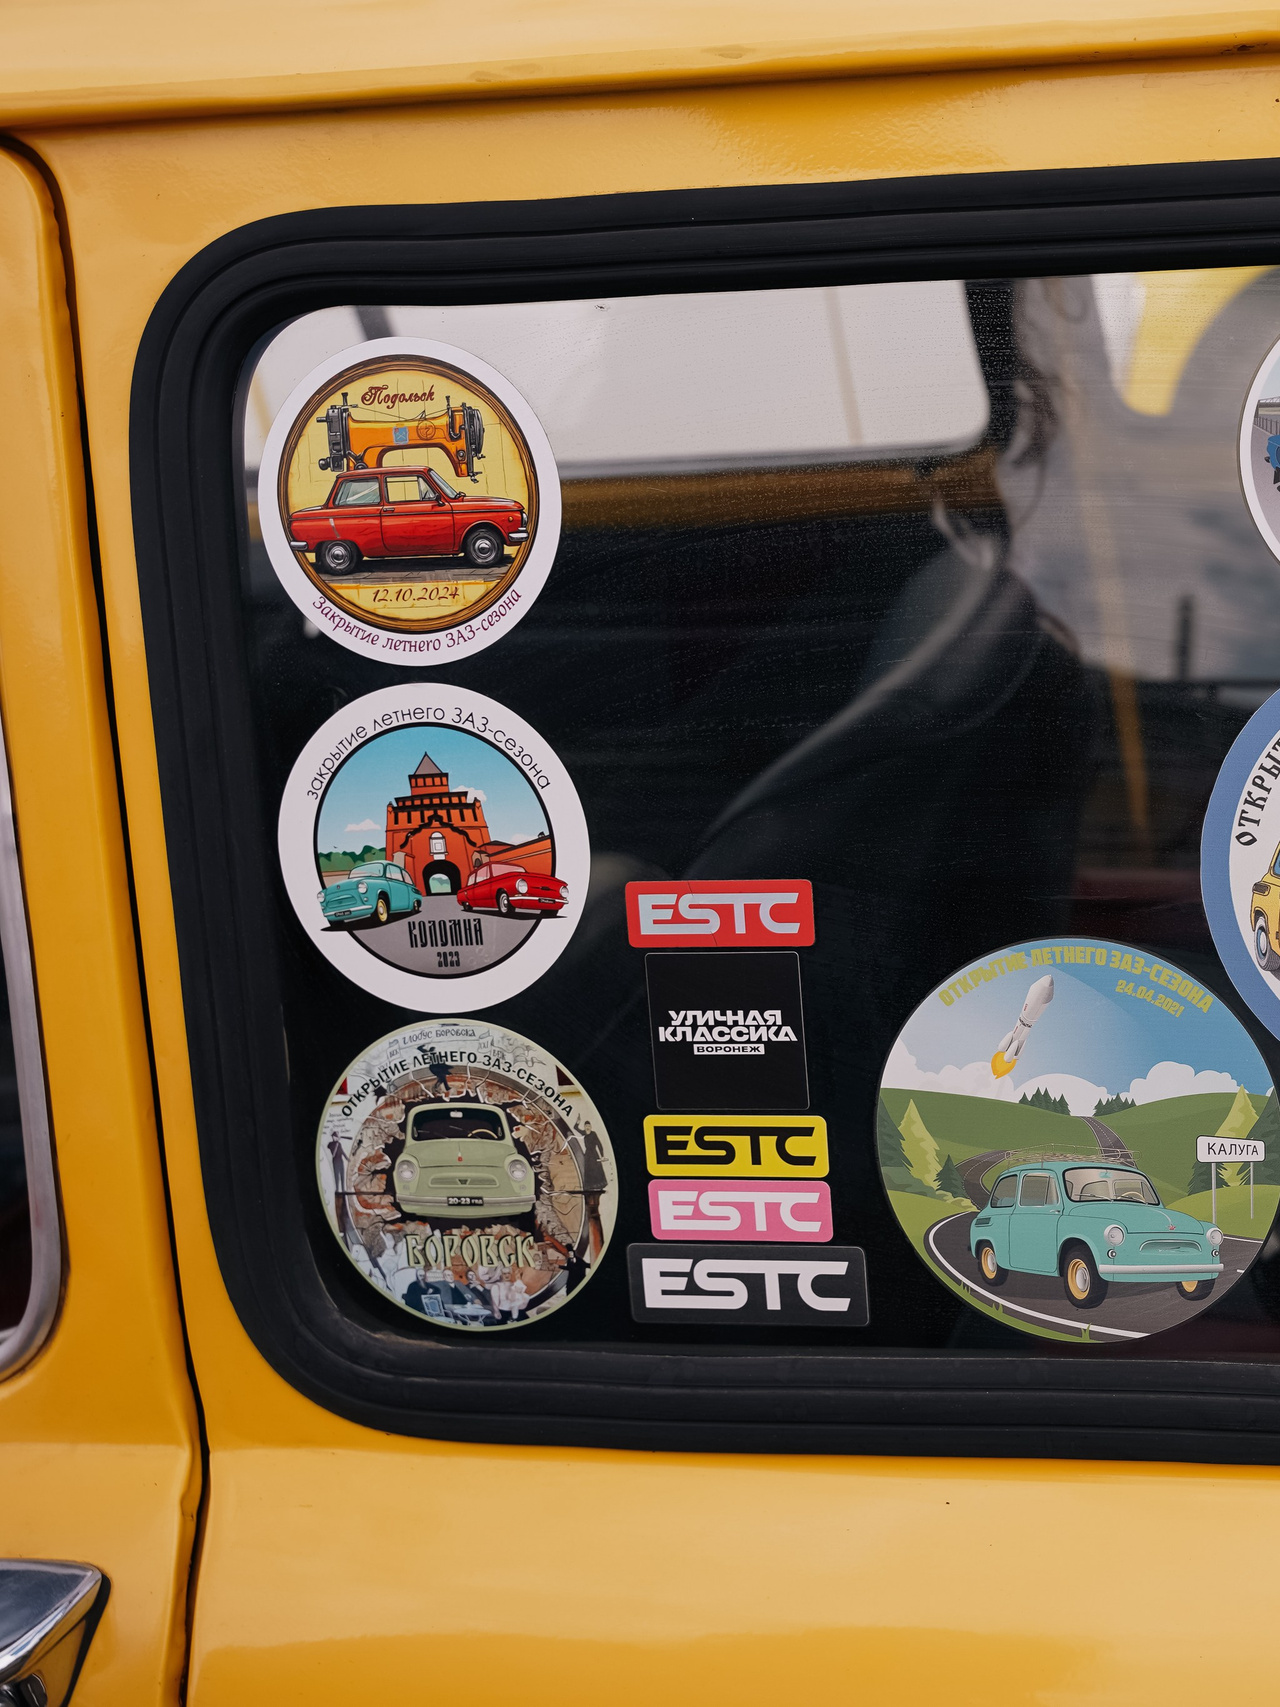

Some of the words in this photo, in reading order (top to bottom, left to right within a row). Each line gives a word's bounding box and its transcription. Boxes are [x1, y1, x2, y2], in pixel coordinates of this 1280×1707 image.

[361, 384, 435, 409] Подольск
[372, 585, 460, 603] 12.10.2024
[312, 596, 380, 646] Закрытие
[382, 638, 442, 652] летнего
[445, 588, 522, 648] ЗАЗ-сезона
[306, 724, 368, 800] закрытие
[372, 707, 445, 732] летнего
[451, 707, 551, 790] ЗАЗ-сезона
[637, 892, 801, 935] ESTC
[407, 917, 484, 948] КОЛОМНА
[436, 951, 461, 968] 2023
[938, 952, 1029, 1007] ОТКРЫТИЕ
[1031, 946, 1107, 967] ЛЕТНЕГО
[1109, 950, 1214, 1014] ЗАЗ-СЕЗОНА
[1115, 979, 1185, 1018] 24.04.2021
[658, 1026, 798, 1043] КЛАССИКА
[668, 1010, 782, 1027] УЛИЧНАЯ
[696, 1045, 762, 1054] ВОРОНЕЖ
[342, 1059, 410, 1117] ОТКРЫТИЕ
[413, 1051, 478, 1071] ЛЕТНЕГО
[482, 1054, 574, 1117] ЗАЗ-СЕЗОНА
[653, 1125, 816, 1166] ESTC
[1207, 1142, 1259, 1157] КАЛУГА
[448, 1197, 470, 1205] 20-23
[657, 1190, 823, 1232] ESTC
[406, 1233, 537, 1268] БОРОВСК
[641, 1257, 851, 1311] ESTC
